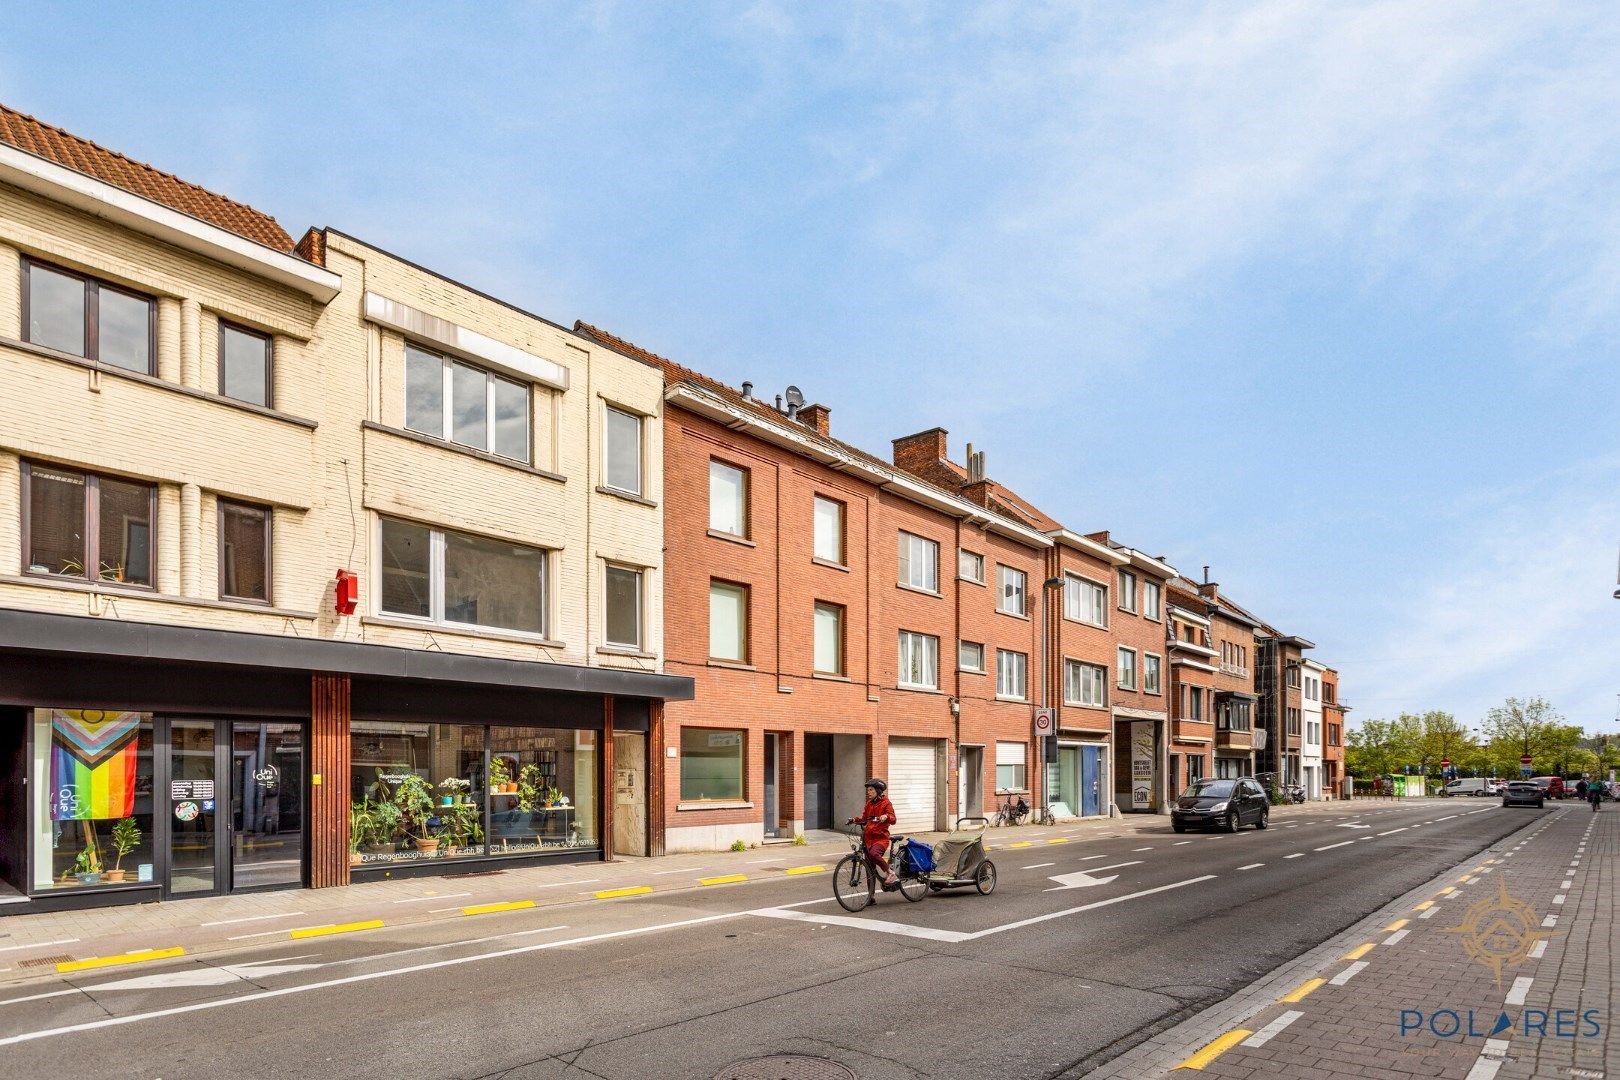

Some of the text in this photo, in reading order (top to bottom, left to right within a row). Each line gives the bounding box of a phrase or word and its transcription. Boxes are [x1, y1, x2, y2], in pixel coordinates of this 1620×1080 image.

[255, 773, 274, 781] Que
[260, 768, 273, 776] Uni
[60, 788, 72, 812] Que
[70, 794, 82, 811] Uni
